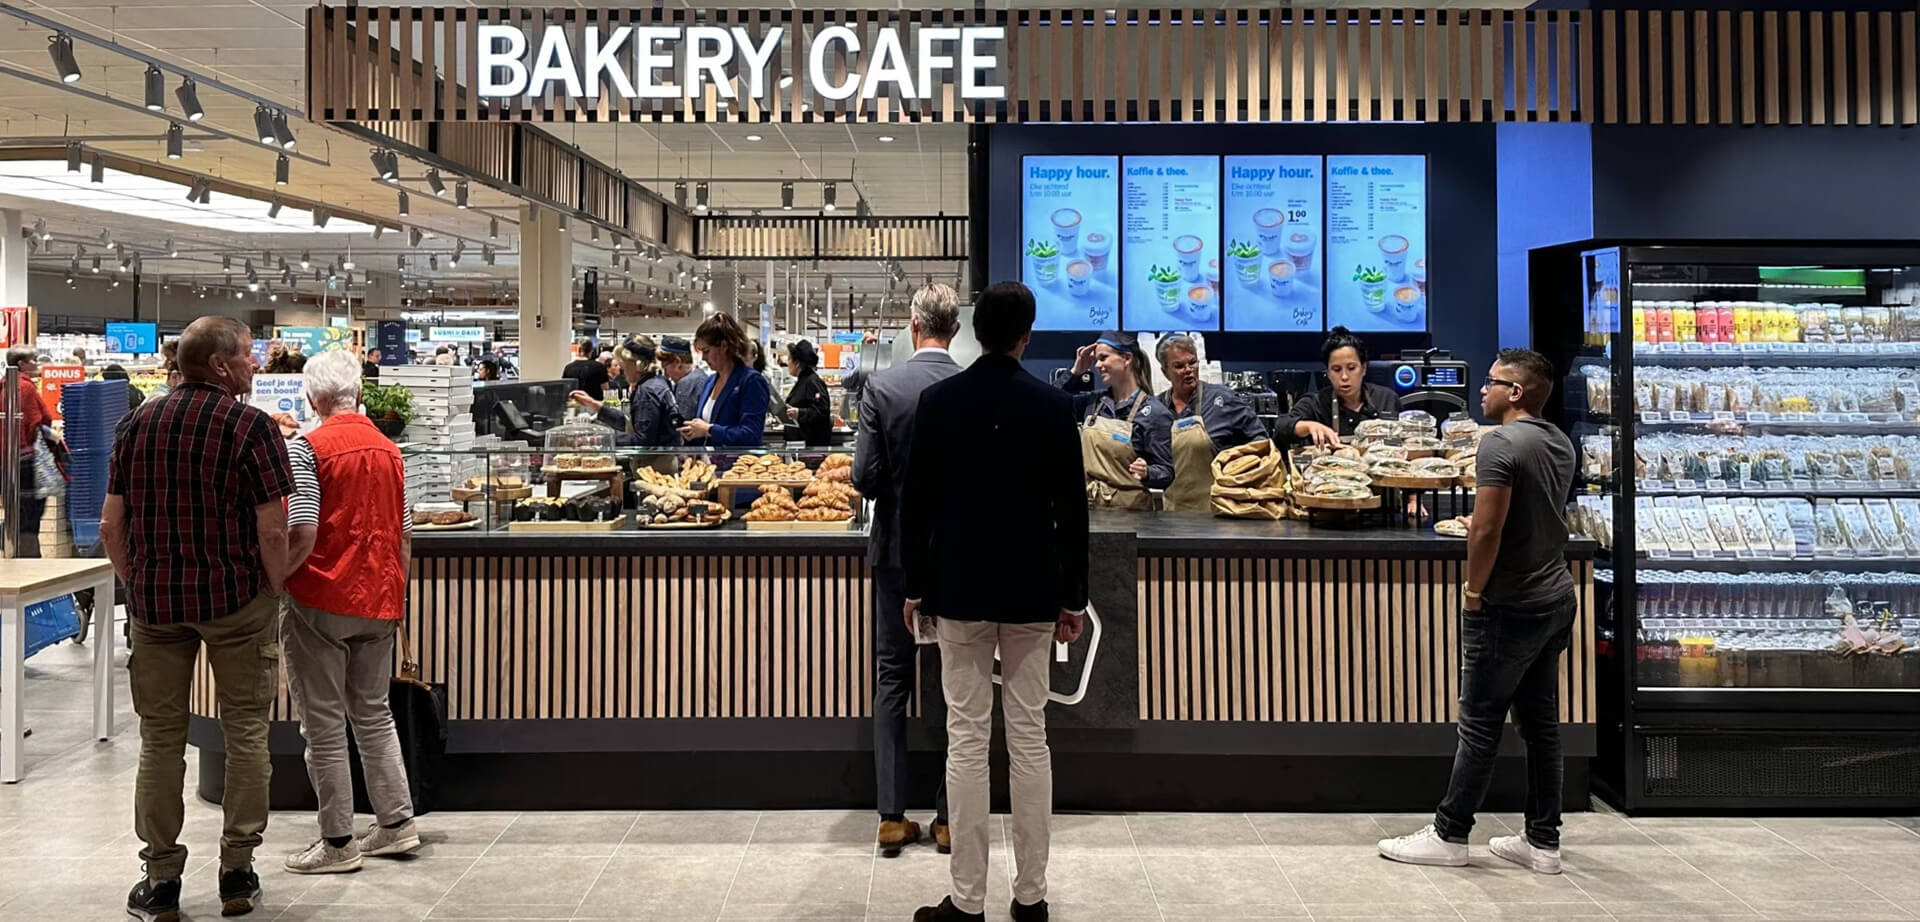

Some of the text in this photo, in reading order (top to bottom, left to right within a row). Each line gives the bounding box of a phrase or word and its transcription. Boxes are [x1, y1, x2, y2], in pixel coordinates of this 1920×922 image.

[477, 25, 1005, 100] BAKERY CAFE
[1030, 165, 1110, 181] Happy hour.
[1127, 167, 1154, 177] Koffie
[1231, 165, 1314, 181] Happy hour.
[1331, 167, 1359, 176] Koffie
[44, 369, 81, 379] BONUS
[256, 379, 276, 387] Geef
[287, 378, 303, 388] dag
[273, 387, 300, 395] boost!
